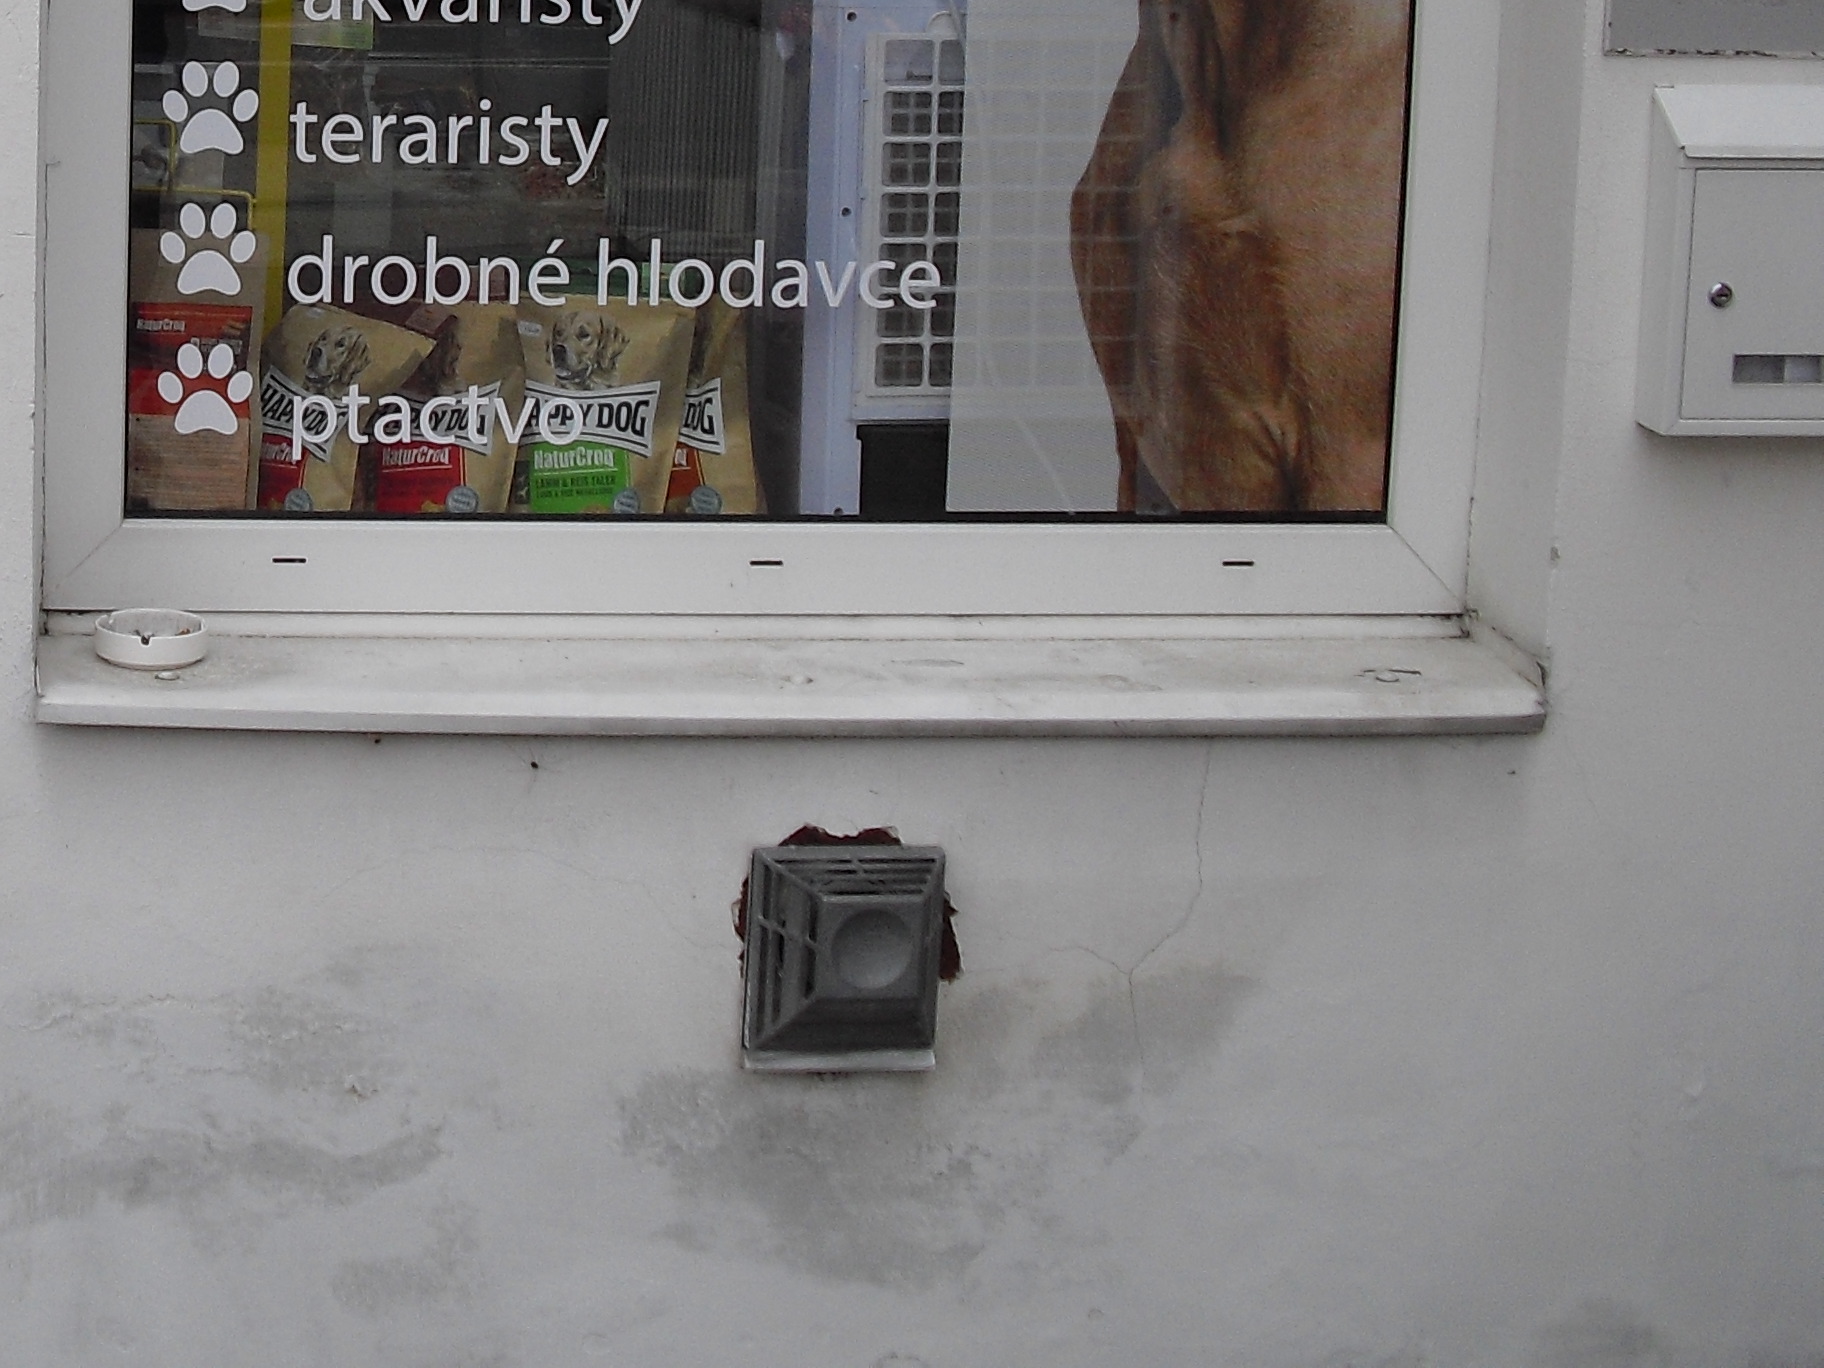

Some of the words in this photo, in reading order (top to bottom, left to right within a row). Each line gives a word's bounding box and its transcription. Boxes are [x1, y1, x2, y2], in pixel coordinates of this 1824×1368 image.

[289, 99, 609, 185] teraristy
[287, 234, 570, 306] drobné
[597, 237, 941, 309] hlodavce
[291, 383, 583, 462] ptactvo
[596, 399, 650, 438] DOG
[533, 446, 615, 469] NaturCroq
